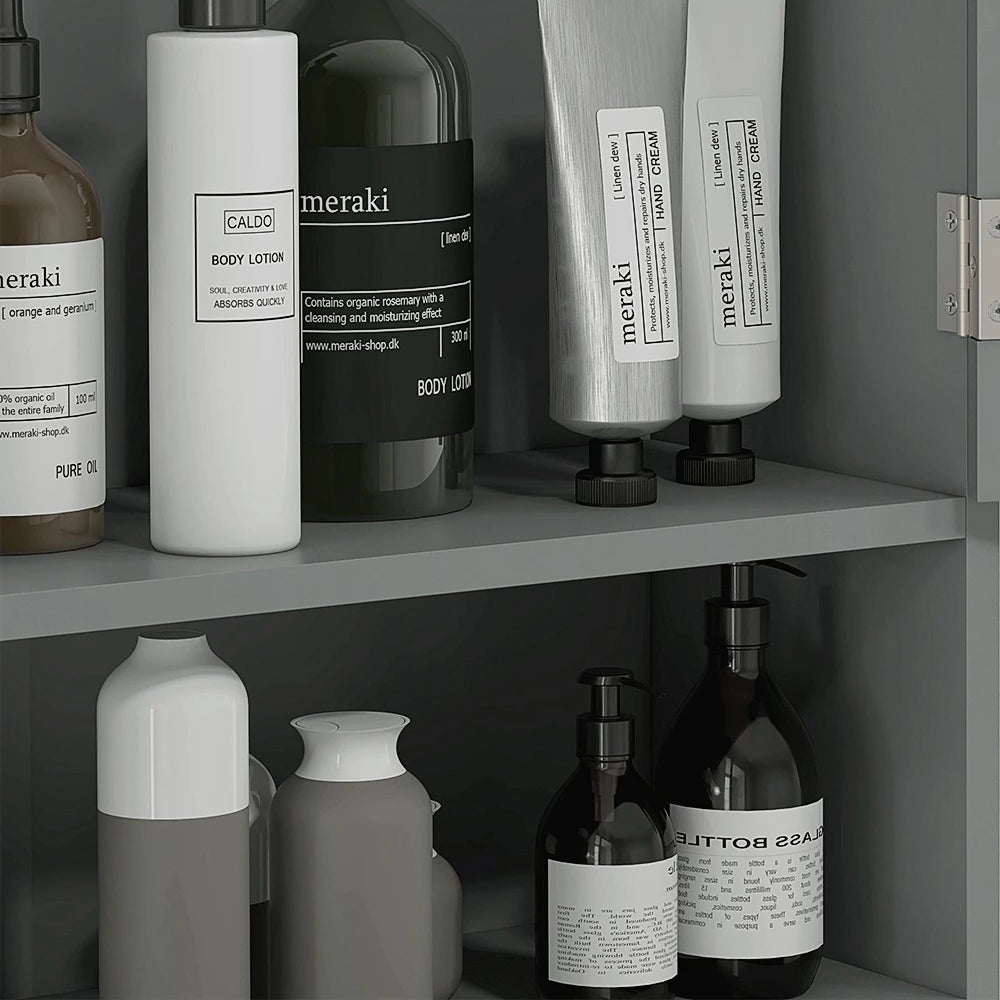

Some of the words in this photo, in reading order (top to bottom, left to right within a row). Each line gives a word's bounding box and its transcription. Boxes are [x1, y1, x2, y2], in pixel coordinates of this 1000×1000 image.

[711, 129, 719, 150] dew
[747, 119, 761, 163] CREAM
[610, 141, 620, 162] dew
[648, 131, 662, 176] CREAM
[734, 141, 743, 166] hands
[635, 153, 644, 179] hands
[713, 153, 723, 180] Linen
[613, 165, 623, 192] Linen
[638, 181, 646, 195] dry
[752, 171, 763, 206] HAND
[300, 187, 390, 213] meraki
[653, 184, 665, 220] HAND
[740, 184, 749, 211] repairs
[640, 196, 649, 225] repairs
[227, 215, 273, 229] CALDO
[741, 214, 749, 230] and
[642, 227, 650, 243] and
[211, 254, 245, 266] BODY
[249, 251, 284, 265] LOTION
[744, 231, 753, 277] moisturizes
[0, 266, 61, 289] eraki
[645, 246, 654, 292] moisturizes
[758, 227, 769, 312] www.meraki-shop.dk
[209, 287, 230, 295] SOUL,
[232, 284, 270, 294] CREATIVITY
[275, 282, 288, 291] LOVE
[658, 241, 670, 328] www.meraki-shop.dk
[713, 247, 737, 328] meraki
[9, 308, 42, 320] orange
[45, 305, 61, 316] and
[63, 302, 94, 317] geranium
[213, 299, 254, 309] ABSORBS
[256, 296, 286, 307] QUICKLY
[304, 296, 344, 308] Contains
[346, 296, 380, 309] organic
[382, 295, 420, 307] rosemary
[422, 292, 438, 304] with
[438, 293, 444, 303] a
[612, 261, 637, 345] meraki
[304, 312, 347, 325] cleansing
[349, 311, 367, 323] and
[369, 309, 420, 323] moisturizing
[421, 307, 442, 320] effect
[648, 295, 657, 332] Protects,
[305, 338, 400, 352] www.meraki-shop.dk
[451, 330, 463, 343] 300
[417, 377, 447, 397] BODY
[14, 393, 45, 405] organic
[46, 392, 55, 401] oil
[76, 394, 87, 405] 100
[2, 407, 16, 416] the
[18, 406, 41, 416] entire
[43, 404, 65, 414] family
[56, 462, 82, 480] PURE
[86, 460, 98, 475] OIL
